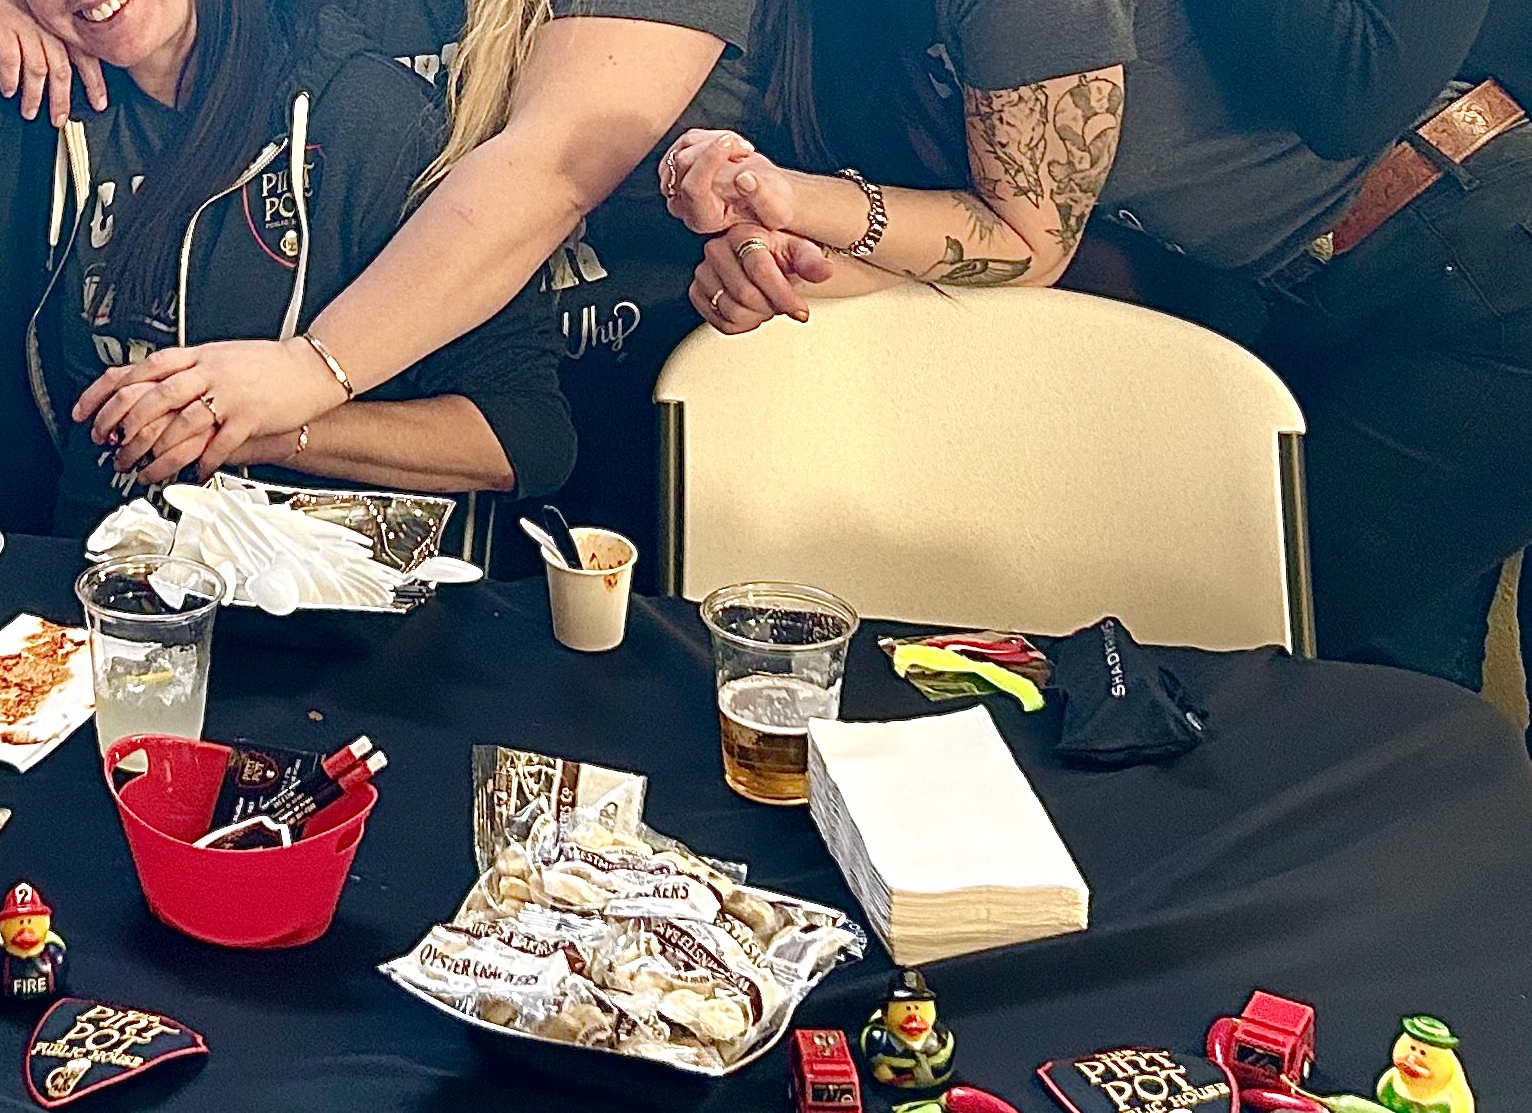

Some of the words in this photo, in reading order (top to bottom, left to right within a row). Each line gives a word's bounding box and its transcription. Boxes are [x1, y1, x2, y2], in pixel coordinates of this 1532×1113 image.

[420, 943, 472, 978] OYSTER
[13, 977, 47, 995] FIRE
[56, 1022, 152, 1054] POT
[76, 1005, 181, 1039] PINT
[30, 1042, 87, 1059] PUBLIC
[88, 1049, 144, 1069] HOUSE
[1074, 1051, 1177, 1086] PINT
[1100, 1065, 1194, 1112] POT
[1168, 1082, 1231, 1108] HOUSE
